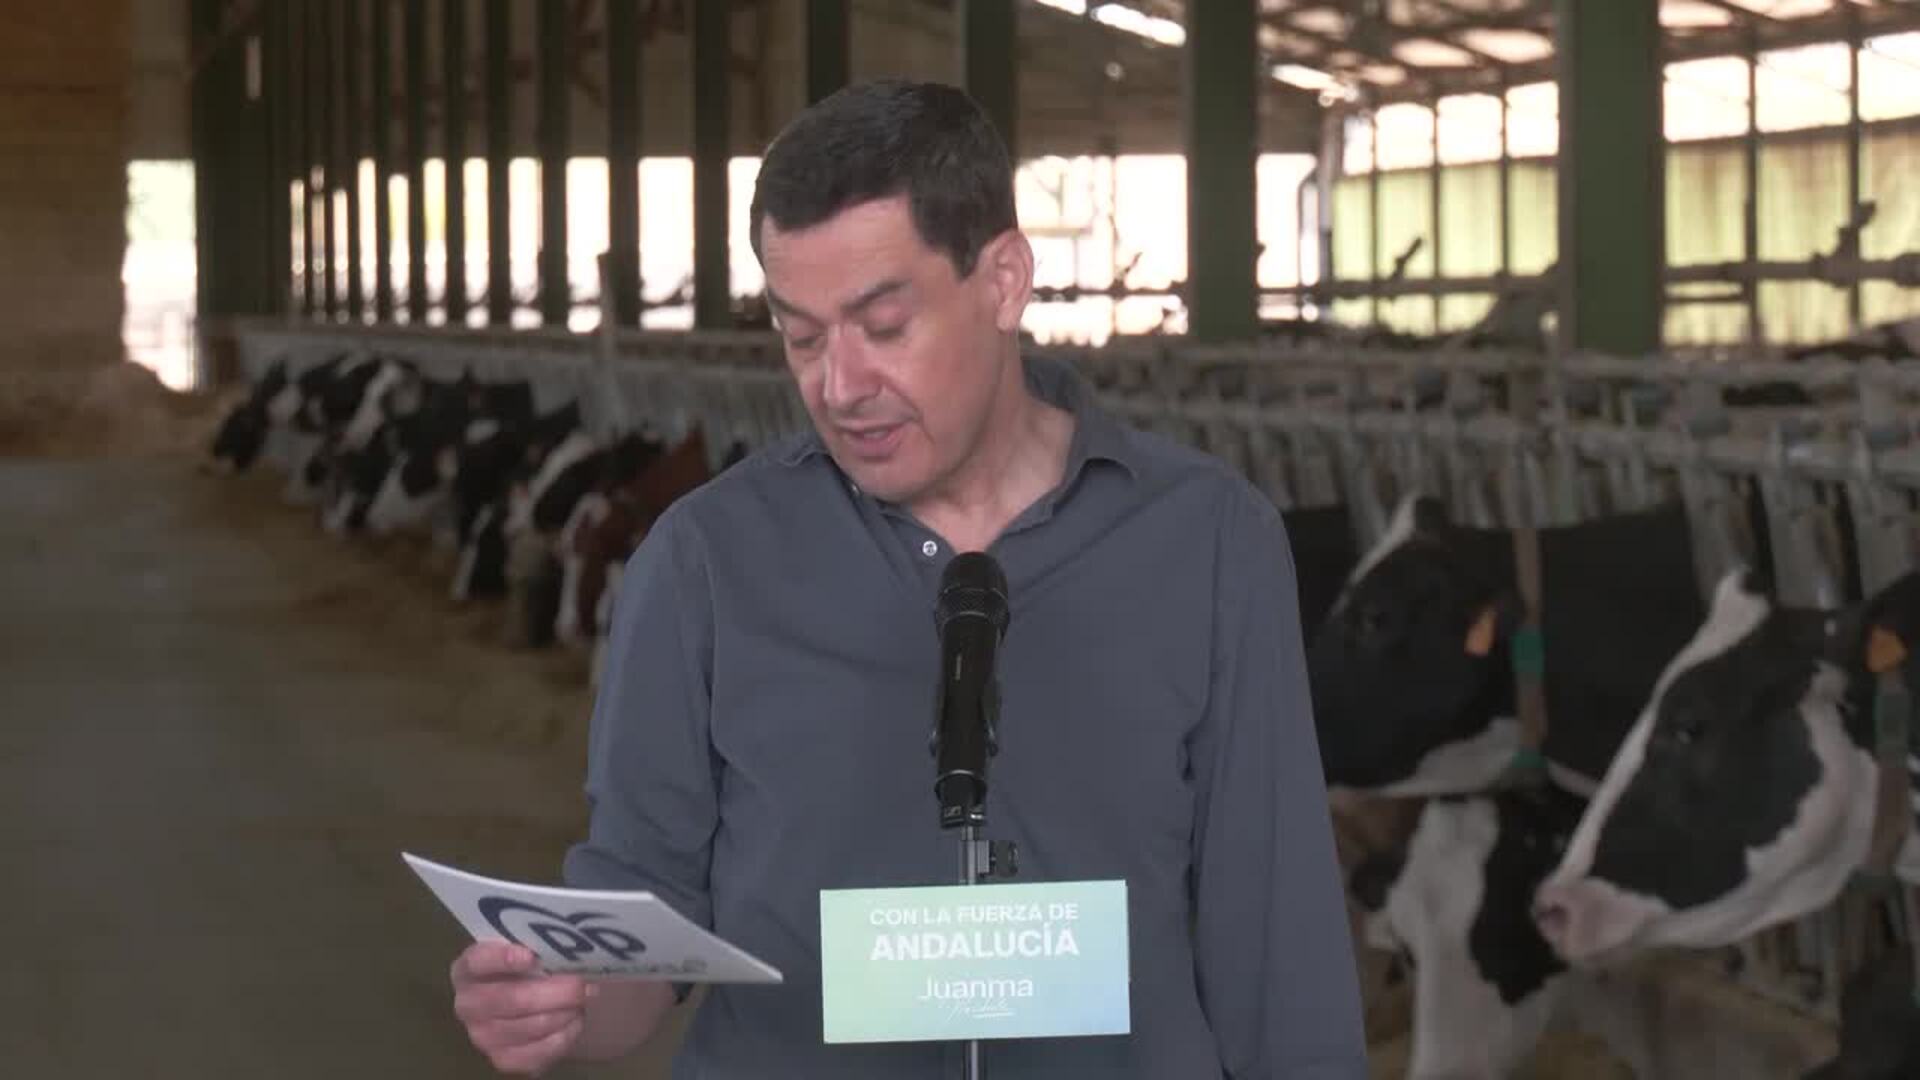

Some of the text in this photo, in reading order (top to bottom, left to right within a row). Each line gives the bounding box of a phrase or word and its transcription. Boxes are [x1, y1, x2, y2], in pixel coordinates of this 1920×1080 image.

[870, 903, 1079, 925] CON LA FUERZA DE
[870, 923, 1080, 960] ANDALUCÍA
[917, 976, 1033, 1000] Juanma
